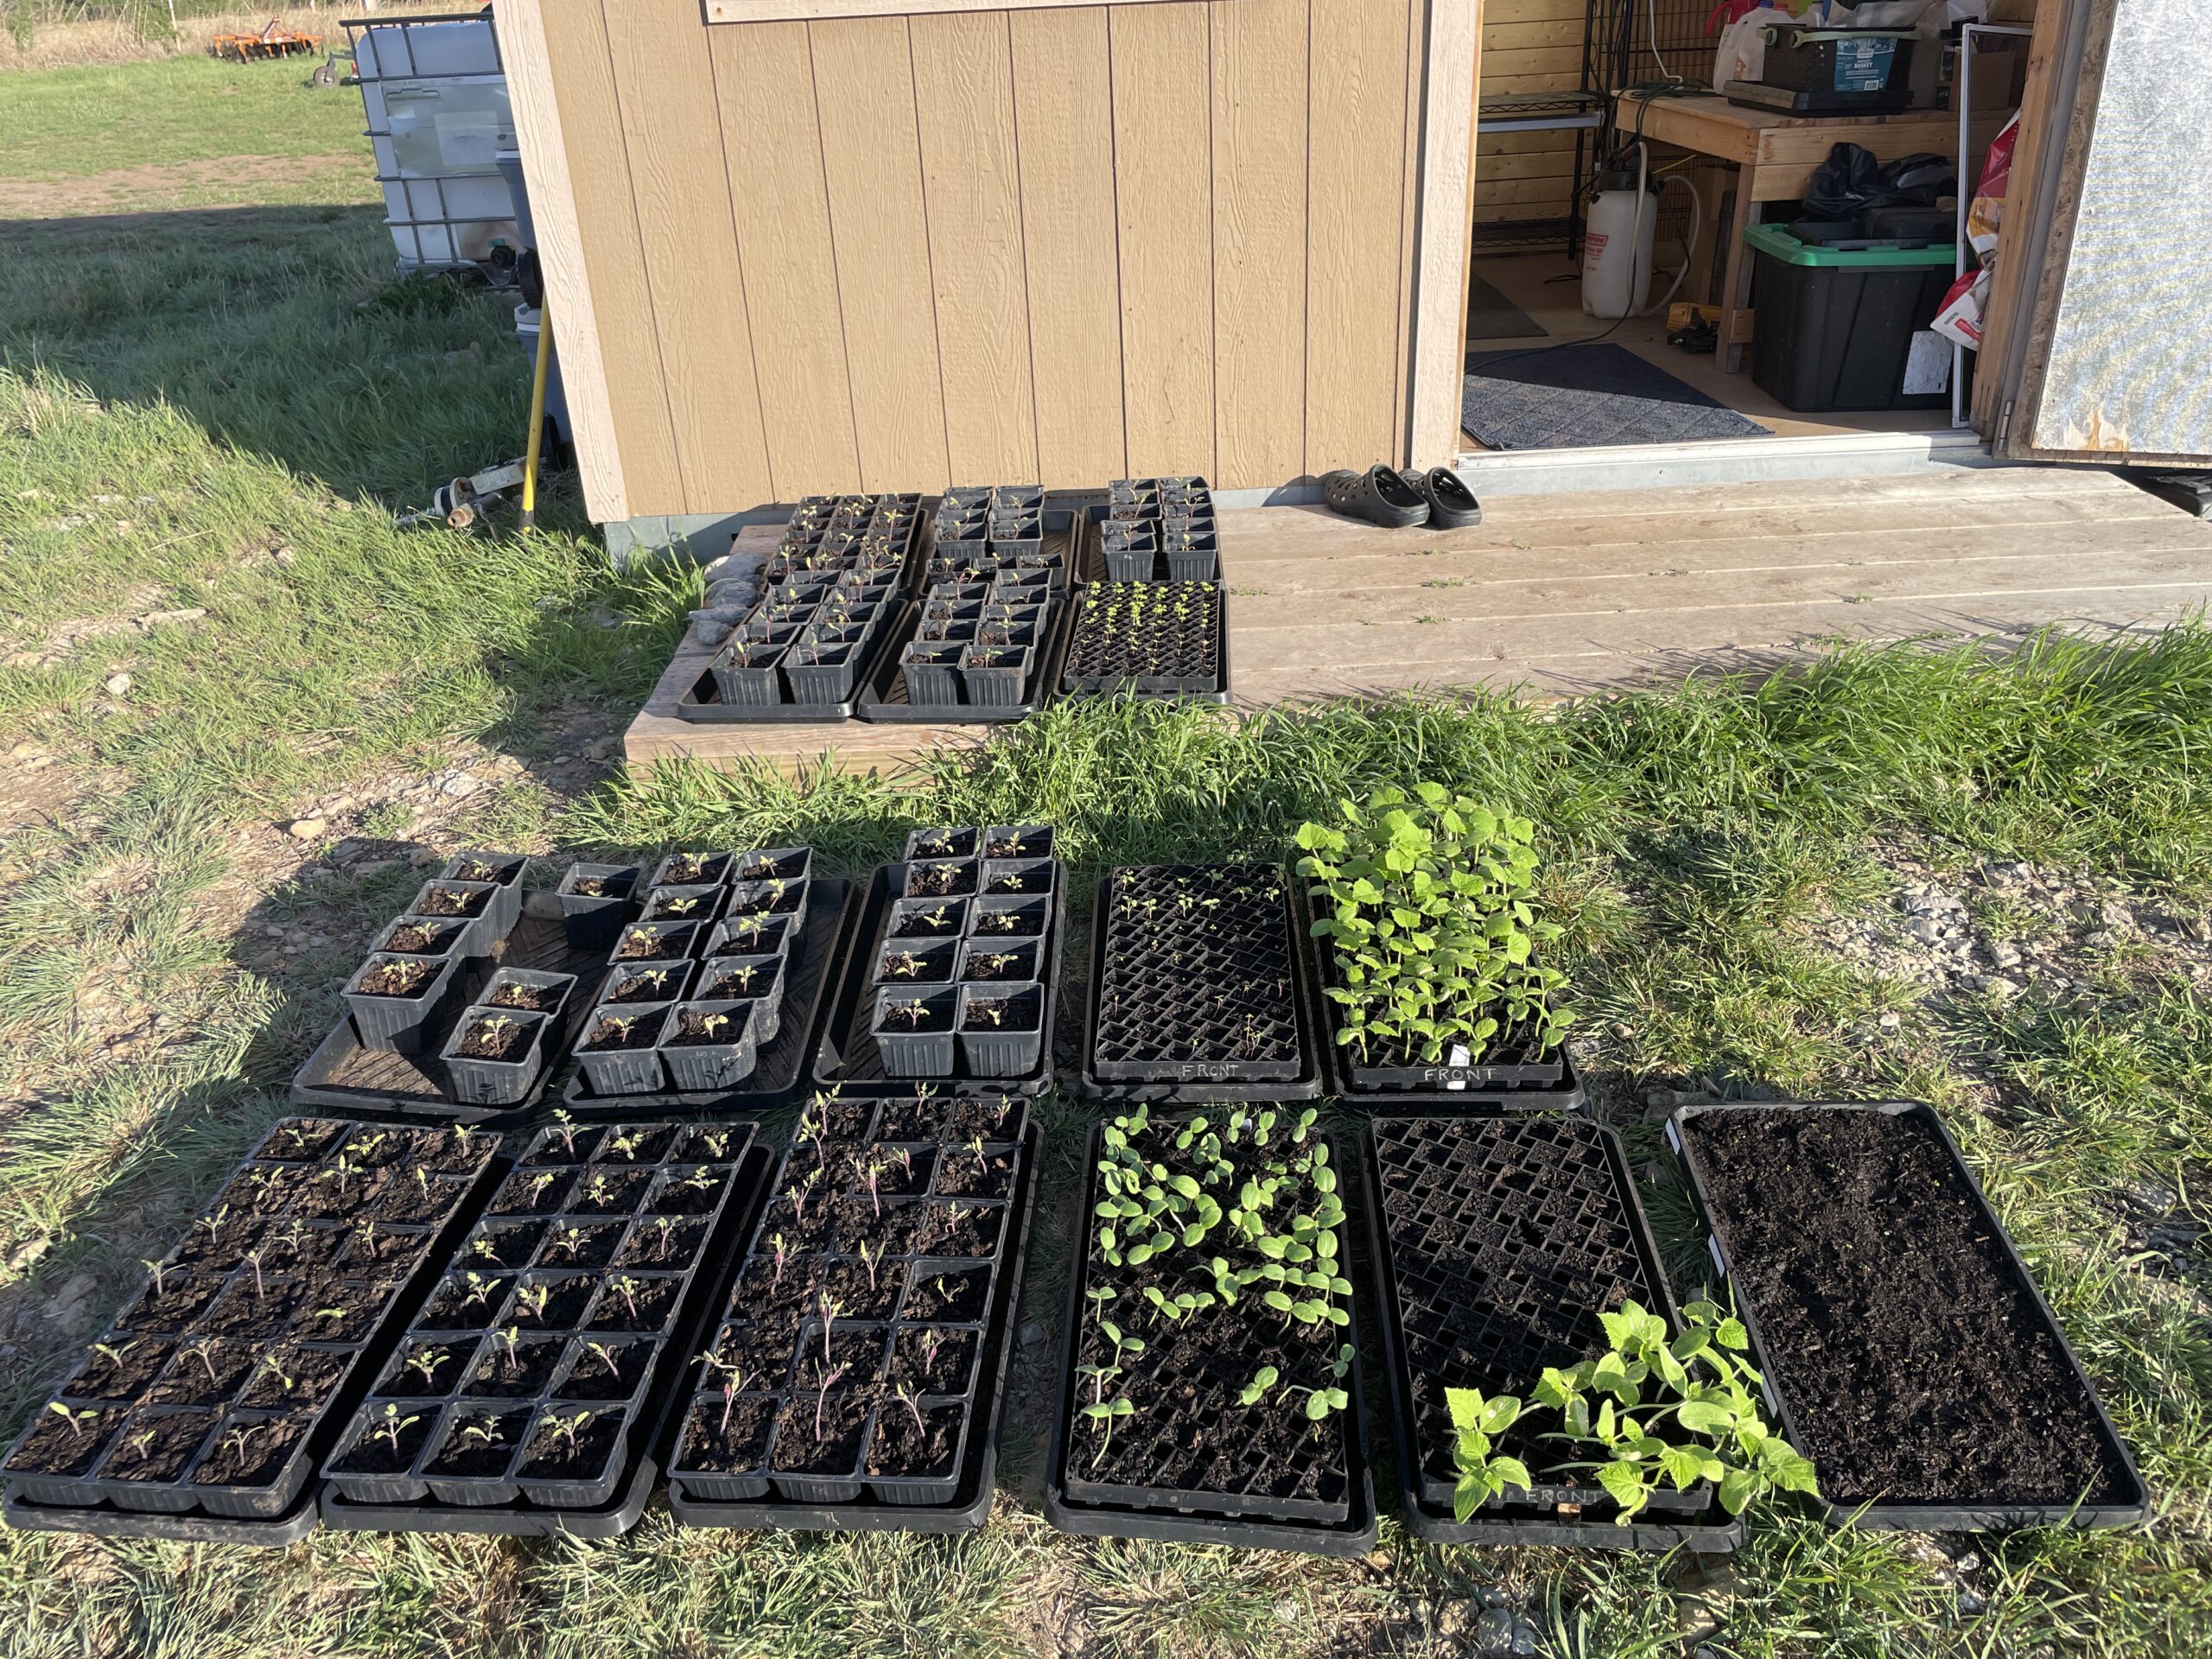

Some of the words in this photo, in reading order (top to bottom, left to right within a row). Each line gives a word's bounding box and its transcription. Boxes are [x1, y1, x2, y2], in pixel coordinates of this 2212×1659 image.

[1182, 1064, 1239, 1077] FRONT
[1424, 1066, 1497, 1081] FRONT
[1526, 1488, 1604, 1503] FRONT
